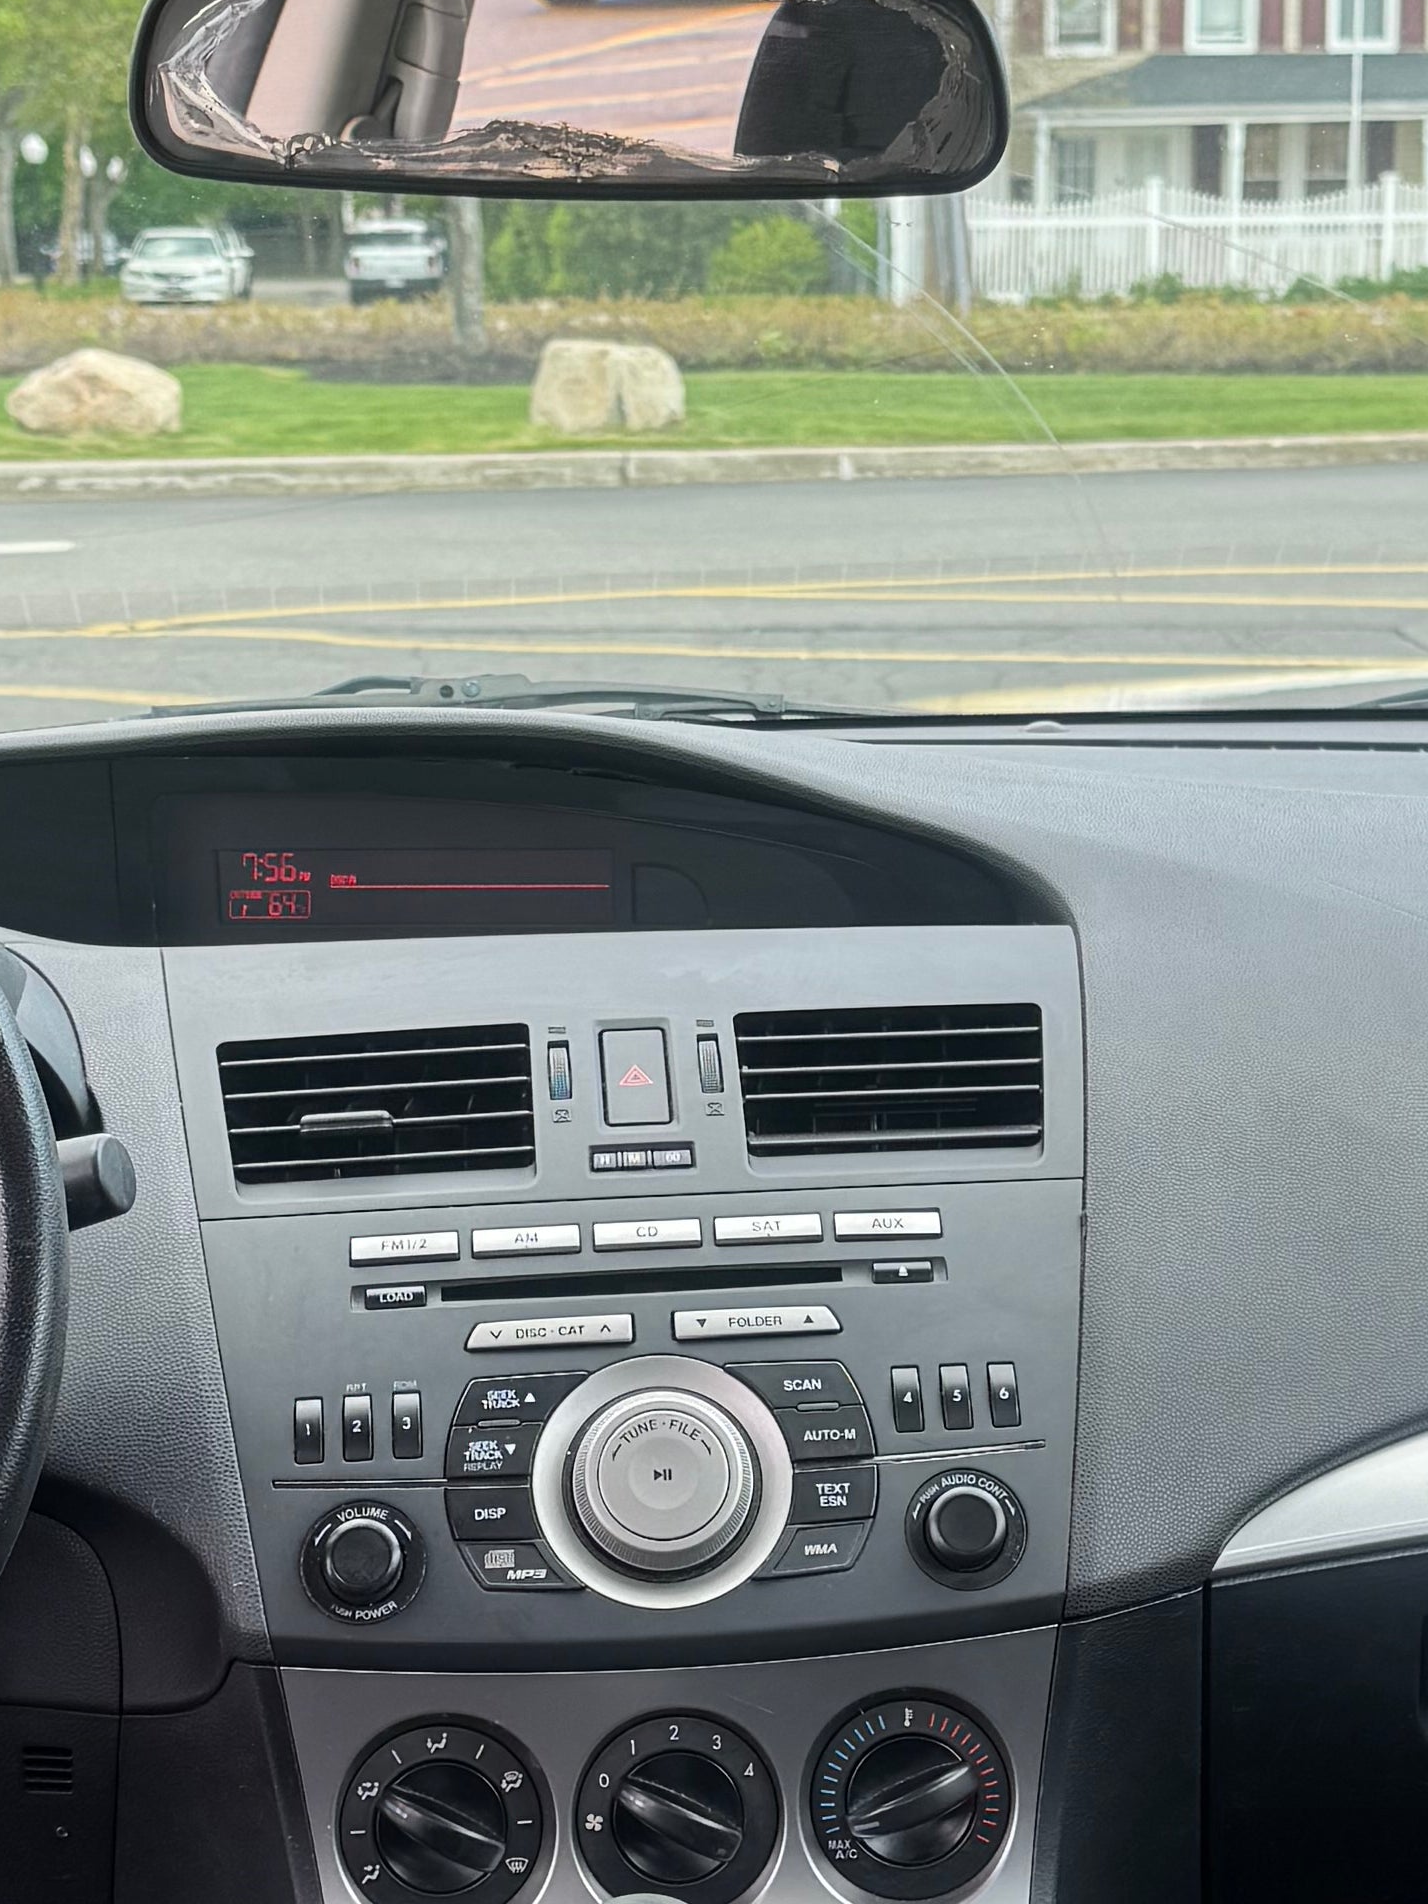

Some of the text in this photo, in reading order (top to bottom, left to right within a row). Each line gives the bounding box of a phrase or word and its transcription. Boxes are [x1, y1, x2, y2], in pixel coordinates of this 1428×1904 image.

[241, 852, 297, 883] 7:56
[752, 1220, 782, 1233] SAT
[871, 1217, 905, 1230] AUX
[514, 1231, 539, 1245] AM
[636, 1225, 659, 1239] CD
[380, 1237, 429, 1252] FM1/2
[379, 1290, 414, 1304] LOAD
[728, 1314, 783, 1329] FOLDER
[515, 1325, 586, 1339] DISC CAT
[783, 1378, 822, 1392] SCAN
[486, 1389, 517, 1401] SEEK
[903, 1391, 913, 1404] 4
[952, 1389, 962, 1402] 5
[999, 1387, 1010, 1400] 6
[481, 1398, 521, 1411] TRACK
[304, 1422, 311, 1437] 1
[352, 1419, 363, 1434] 2
[402, 1416, 412, 1431] 3
[619, 1418, 703, 1444] TUNE FILE
[803, 1428, 857, 1442] AUTO-M
[468, 1440, 499, 1451] SEEK
[463, 1449, 504, 1461] TRACK
[463, 1461, 504, 1472] REPLAY
[815, 1482, 851, 1495] TEXT
[919, 1473, 1009, 1504] PUSH AUDIO CONT
[819, 1495, 848, 1508] ESN
[336, 1507, 390, 1523] VOLUME
[474, 1507, 507, 1521] DISP
[804, 1542, 838, 1556] WMA
[506, 1568, 548, 1581] MP3
[330, 1600, 399, 1621] PUSH POWER
[669, 1724, 680, 1741] 2
[630, 1739, 636, 1756] 1
[712, 1734, 722, 1750] 3
[743, 1762, 754, 1777] 4
[598, 1772, 610, 1788] 0
[828, 1839, 851, 1850] MAX
[835, 1848, 858, 1860] A/C
